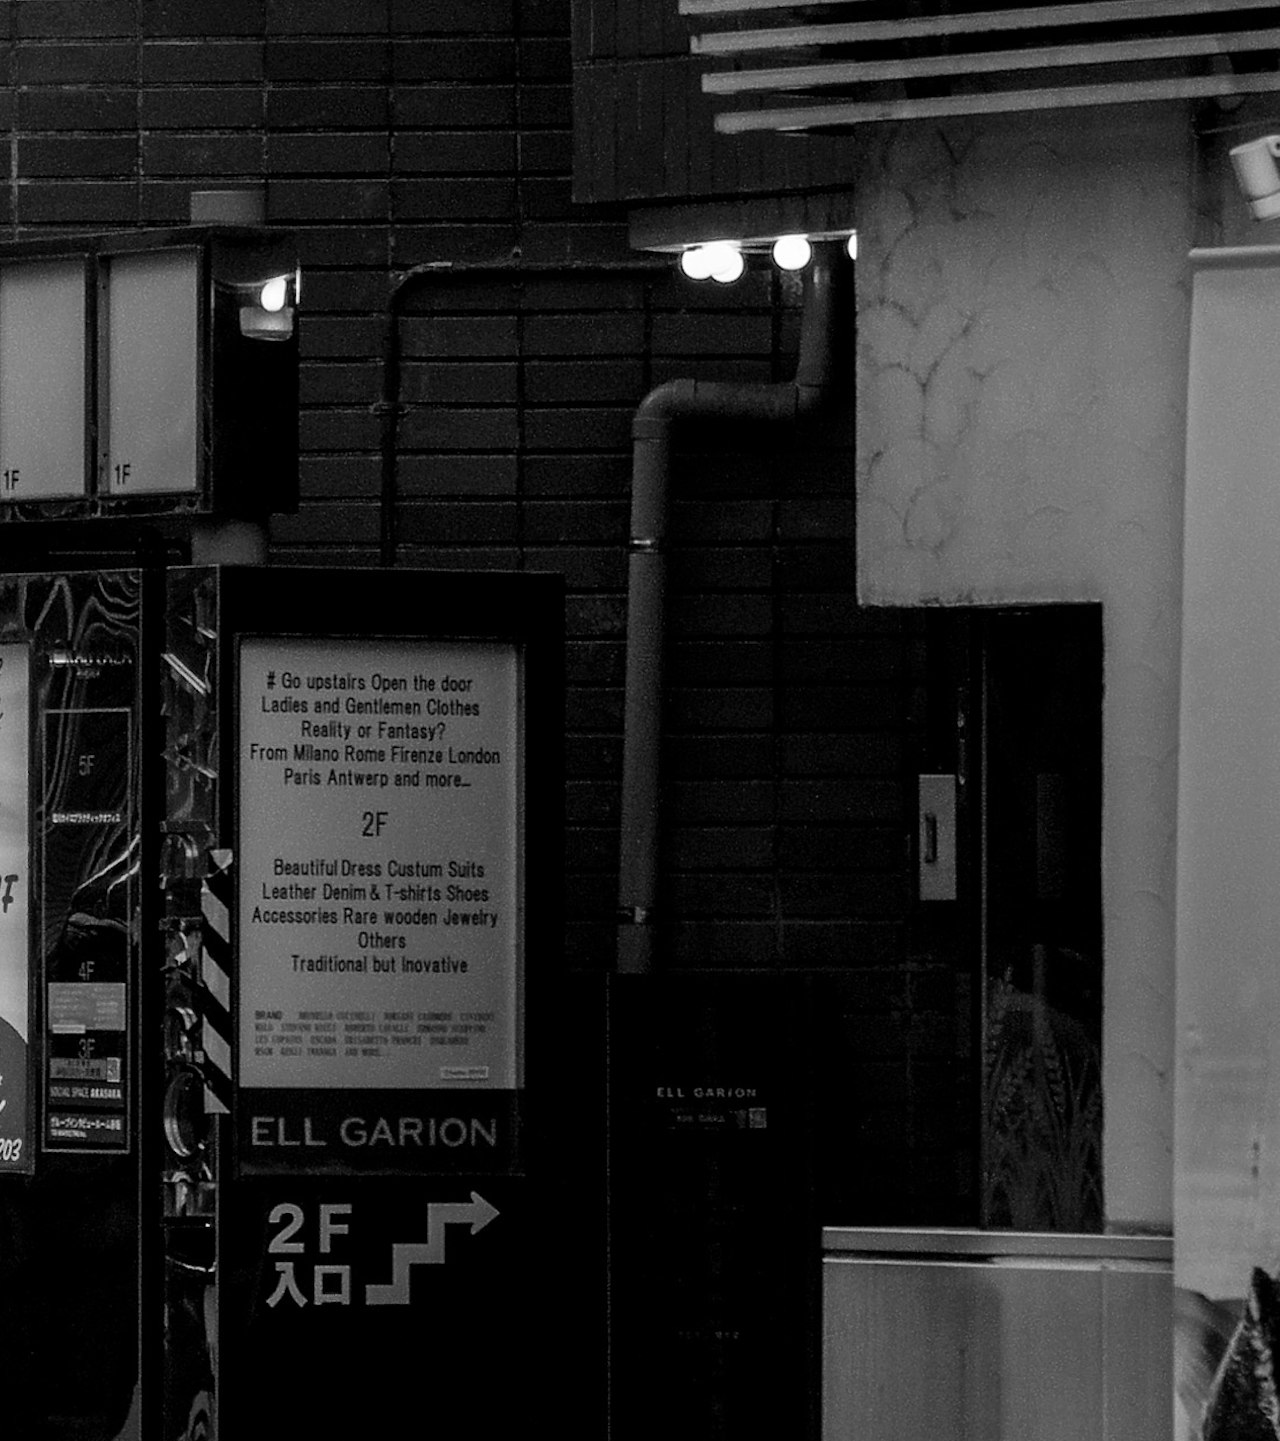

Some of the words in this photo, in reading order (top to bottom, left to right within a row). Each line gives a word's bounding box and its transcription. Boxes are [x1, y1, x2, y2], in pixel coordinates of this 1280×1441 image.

[4, 470, 20, 491] 1F
[114, 464, 131, 485] 1F
[282, 673, 301, 690] Go
[307, 673, 366, 691] upstairs
[372, 675, 407, 692] Open
[414, 675, 435, 691] the
[441, 677, 472, 692] door
[262, 697, 308, 713] Ladies
[314, 698, 339, 714] and
[346, 698, 421, 715] Gentlemen
[427, 699, 479, 716] Clothes
[301, 720, 350, 740] Reality
[358, 724, 371, 738] or
[379, 722, 445, 741] Fantasy?
[250, 744, 288, 761] From
[293, 745, 338, 761] Milano
[345, 746, 385, 762] Rome
[392, 746, 442, 763] Firenze
[449, 748, 500, 764] London
[285, 769, 320, 785] Paris
[327, 770, 388, 788] Antwerp
[394, 771, 419, 786] and
[362, 812, 388, 837] 2F
[274, 859, 338, 876] Beautiful
[342, 860, 381, 877] Dress
[449, 861, 484, 878] Suits
[262, 883, 316, 900] Leather
[323, 884, 366, 901] Denim
[371, 885, 380, 901] &
[385, 885, 441, 902] T-shirts
[448, 885, 489, 902] Shoes
[253, 907, 337, 924] Accessories
[344, 908, 377, 924] Rare
[384, 909, 437, 926] wooden
[444, 909, 498, 928] Jewelry
[359, 932, 406, 949] Others
[291, 955, 368, 973] Traditional
[373, 956, 395, 973] but
[656, 1086, 686, 1099] ELL
[693, 1086, 758, 1099] GARION
[251, 1116, 328, 1146] ELL
[339, 1115, 498, 1148] GARION
[267, 1202, 353, 1254] 2F
[265, 1261, 352, 1309] 入口
